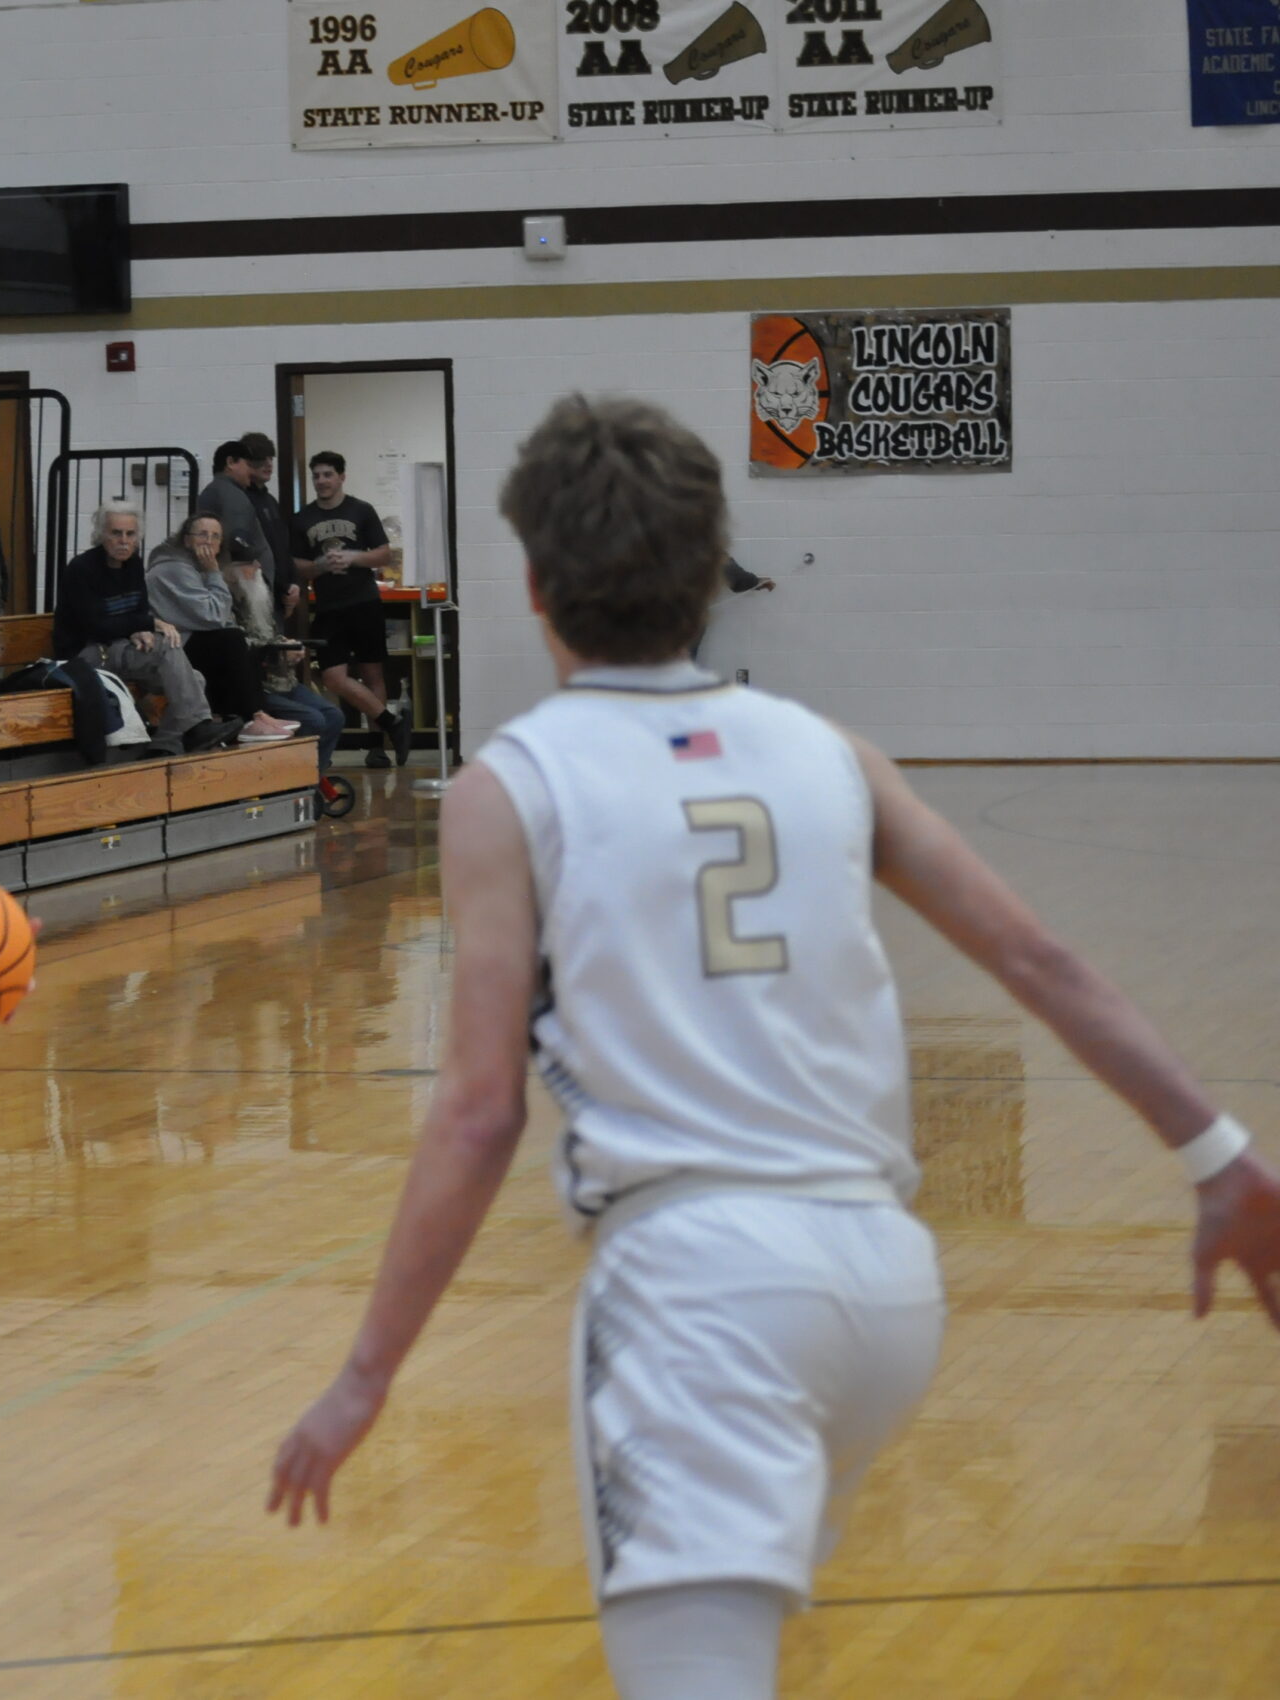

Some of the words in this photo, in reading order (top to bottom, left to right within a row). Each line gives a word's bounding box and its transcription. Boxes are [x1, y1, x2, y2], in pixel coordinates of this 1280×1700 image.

[566, 0, 660, 34] 2008
[785, 0, 882, 24] 2011
[309, 15, 377, 44] 1996
[1205, 27, 1253, 47] STATE
[317, 49, 373, 77] AA
[404, 44, 464, 78] Cougars
[576, 39, 652, 77] AA
[796, 29, 874, 67] AA
[1202, 52, 1275, 74] ACADEMIC
[303, 106, 380, 128] STATE
[389, 101, 544, 126] RUNNER-UP
[568, 102, 635, 127] STATE
[643, 95, 770, 125] RUNNER-UP
[789, 92, 857, 119] STATE
[865, 86, 993, 115] RUNNER-UP
[852, 323, 998, 371] LINCOLN
[849, 371, 997, 415] COUGARS
[814, 419, 1007, 460] BASKETBALL
[679, 794, 789, 979] 2
